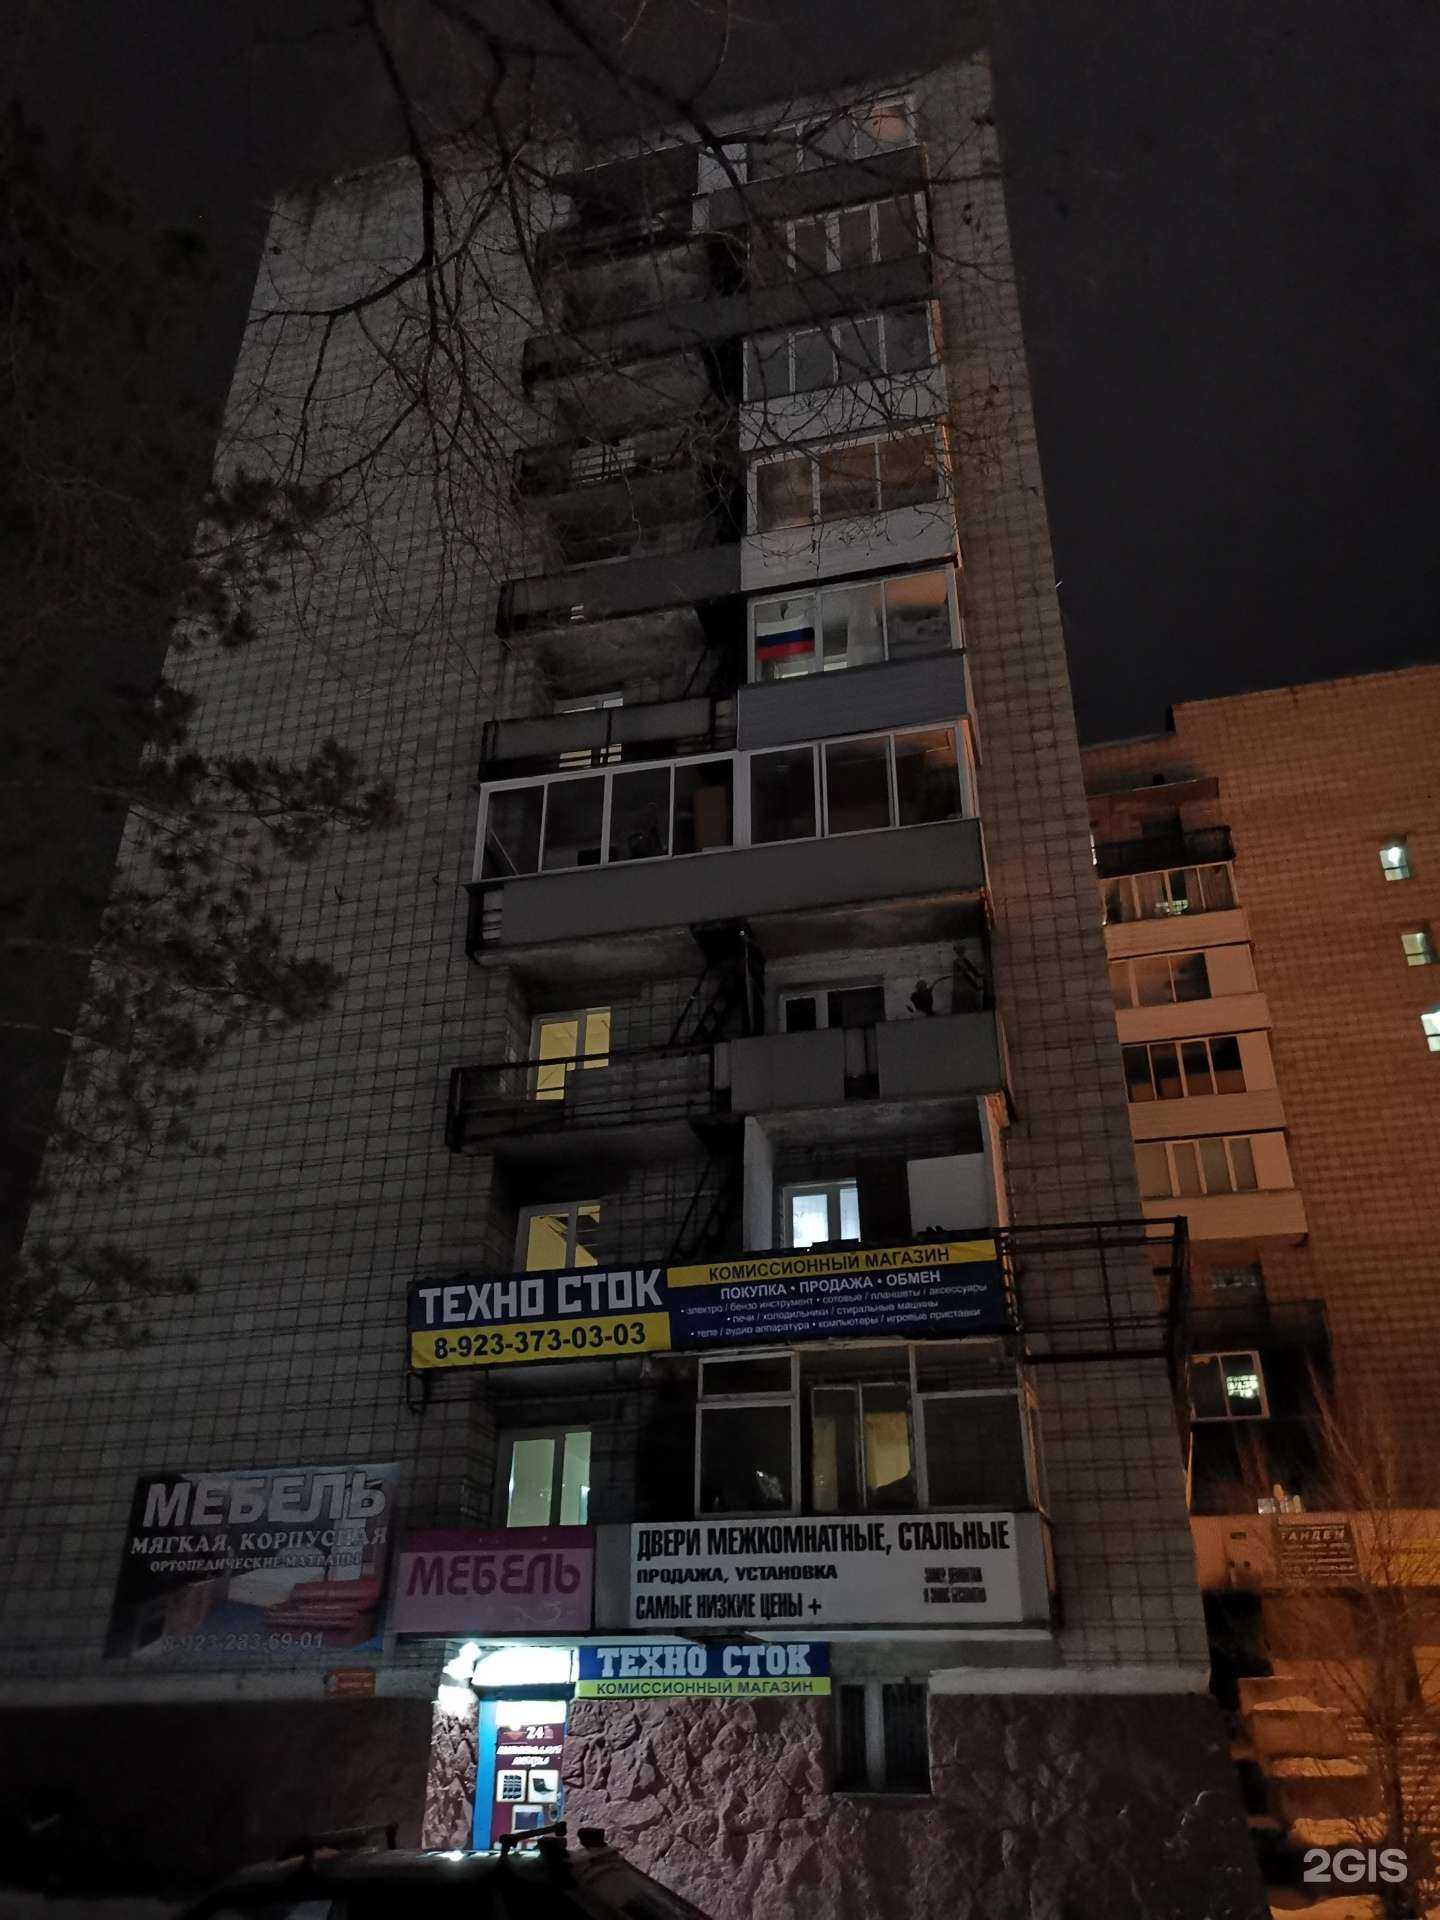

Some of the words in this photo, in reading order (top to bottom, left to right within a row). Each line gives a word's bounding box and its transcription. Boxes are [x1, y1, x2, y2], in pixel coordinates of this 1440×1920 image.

[709, 1254, 860, 1282] КОМИССИОННЫЙ
[865, 1247, 950, 1268] МАГАЗИН
[418, 1278, 545, 1324] ТЕХНО
[557, 1268, 663, 1314] СТОК
[720, 1283, 787, 1300] ПОКУПКА
[799, 1276, 873, 1294] ПРОДАЖА
[886, 1270, 942, 1286] ОБМЕН
[434, 1322, 646, 1360] 8-923-373-03-03
[143, 1472, 387, 1528] МЕБЕЛЬ
[240, 1526, 389, 1551] КОРПУСНАЯ
[637, 1528, 701, 1562] ДВЕРИ
[707, 1523, 892, 1556] МЕЖКОМНАТНЫЕ,
[898, 1520, 1010, 1551] СТАЛЬНЫЕ
[406, 1553, 581, 1596] МЕБЕЛЬ
[636, 1568, 728, 1585] ПРОДАЖА,
[737, 1565, 838, 1581] УСТАНОВКА
[635, 1595, 692, 1620] САМЫЕ
[697, 1593, 755, 1619] НИЗКИЕ
[761, 1592, 803, 1621] ЦЕНЫ
[597, 1645, 708, 1678] ТЕХНО
[722, 1644, 812, 1676] СТОК
[597, 1679, 733, 1695] КОМИССИОННЫЙ
[736, 1680, 813, 1694] МАГАЗИН
